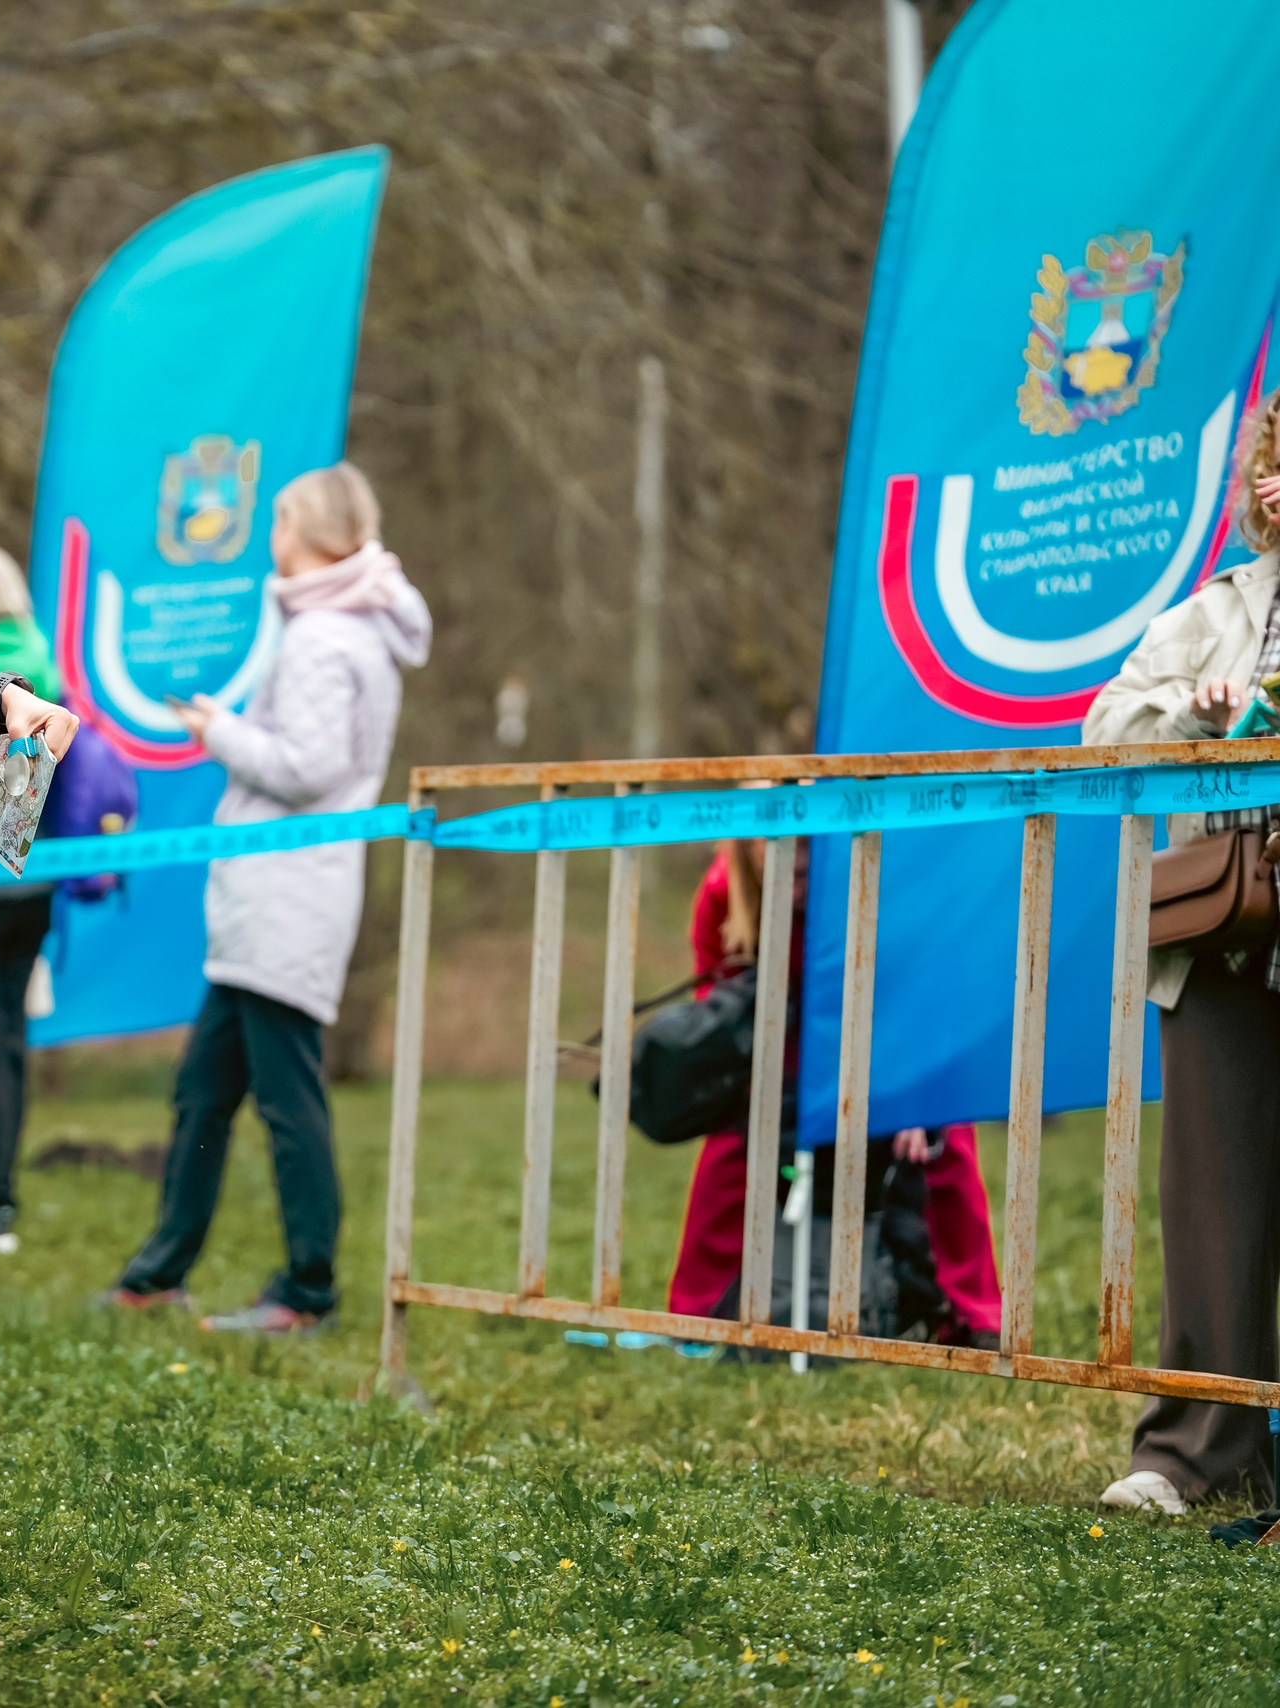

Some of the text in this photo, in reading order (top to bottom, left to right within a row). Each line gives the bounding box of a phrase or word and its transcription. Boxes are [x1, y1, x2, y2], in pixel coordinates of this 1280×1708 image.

[994, 431, 1184, 492] МИНИСЕРСТВО
[1075, 514, 1091, 533] И
[1097, 499, 1180, 532] СПОРТА
[1035, 572, 1092, 596] КРАЯ
